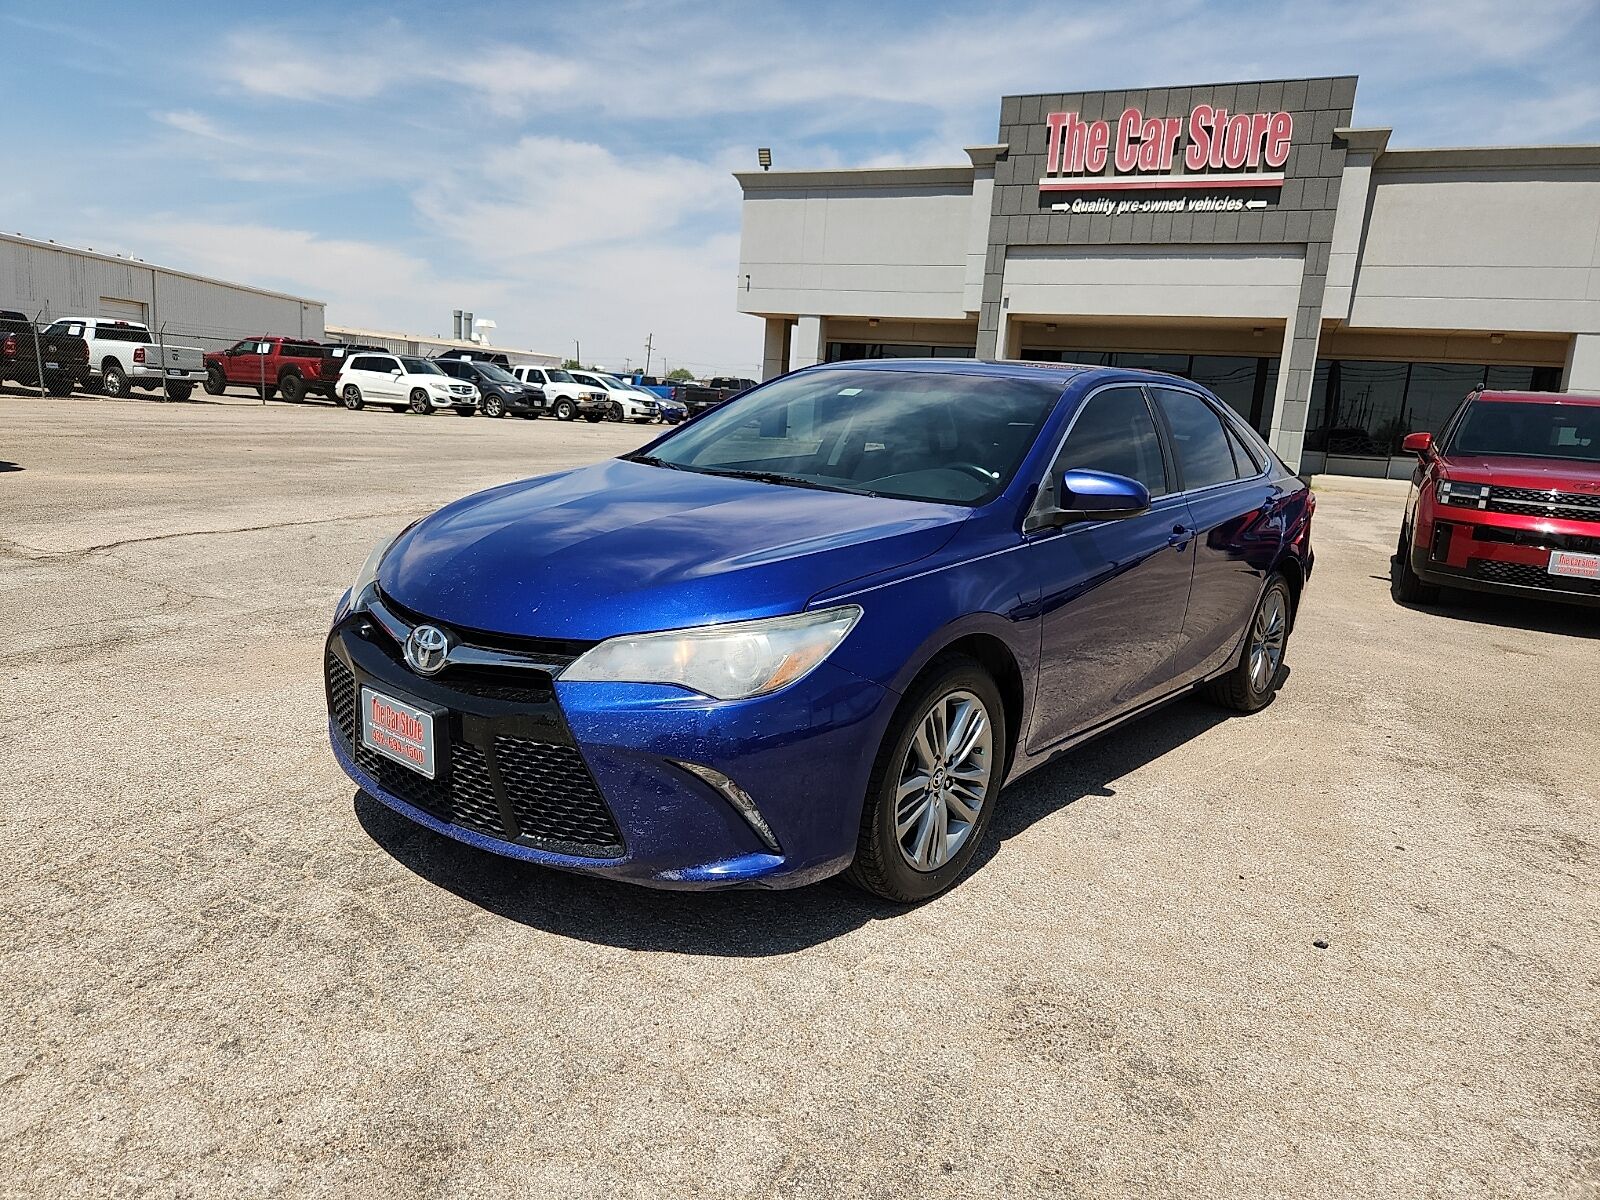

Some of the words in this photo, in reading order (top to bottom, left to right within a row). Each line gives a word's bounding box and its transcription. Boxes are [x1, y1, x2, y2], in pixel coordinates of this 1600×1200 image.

[1046, 112, 1110, 173] The
[1114, 108, 1183, 172] Car
[1185, 104, 1293, 171] Store
[1071, 197, 1116, 216] Quality
[1116, 196, 1187, 216] pre-owned
[1187, 195, 1244, 211] vehicles
[371, 697, 385, 724] The
[386, 705, 399, 732] Car
[399, 710, 424, 742] Store
